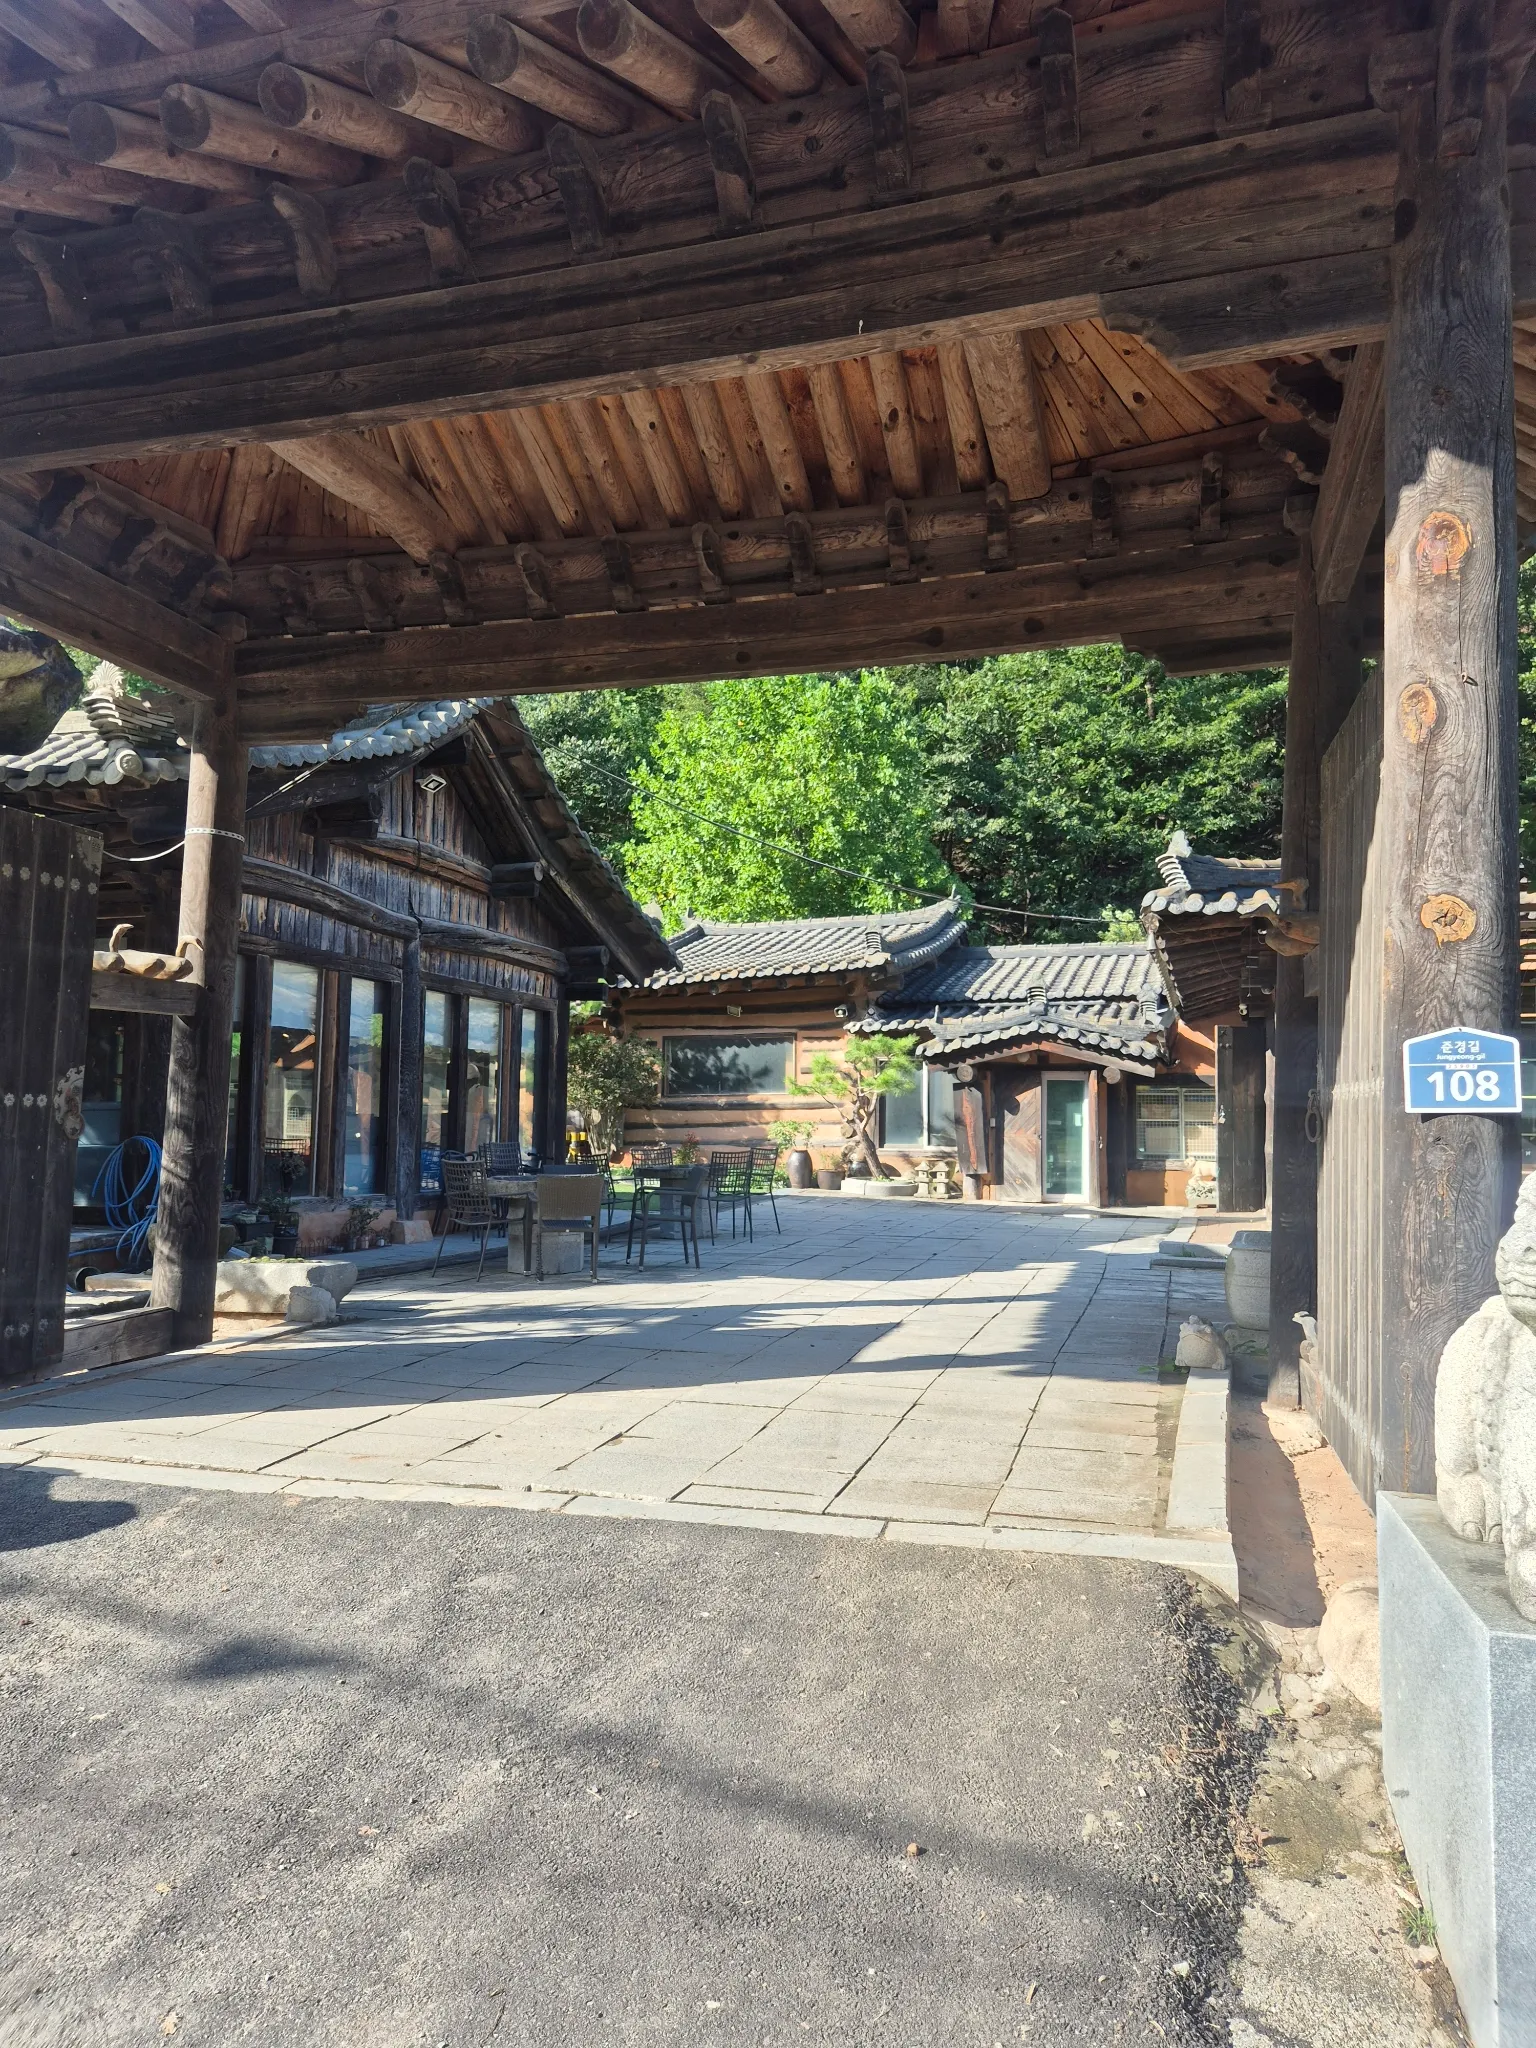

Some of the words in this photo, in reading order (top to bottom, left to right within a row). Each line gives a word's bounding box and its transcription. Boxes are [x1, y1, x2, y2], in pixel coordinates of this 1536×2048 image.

[1441, 1040, 1480, 1053] 준경길
[1436, 1053, 1486, 1061] Jungyeong-gil
[1426, 1070, 1500, 1101] 108
